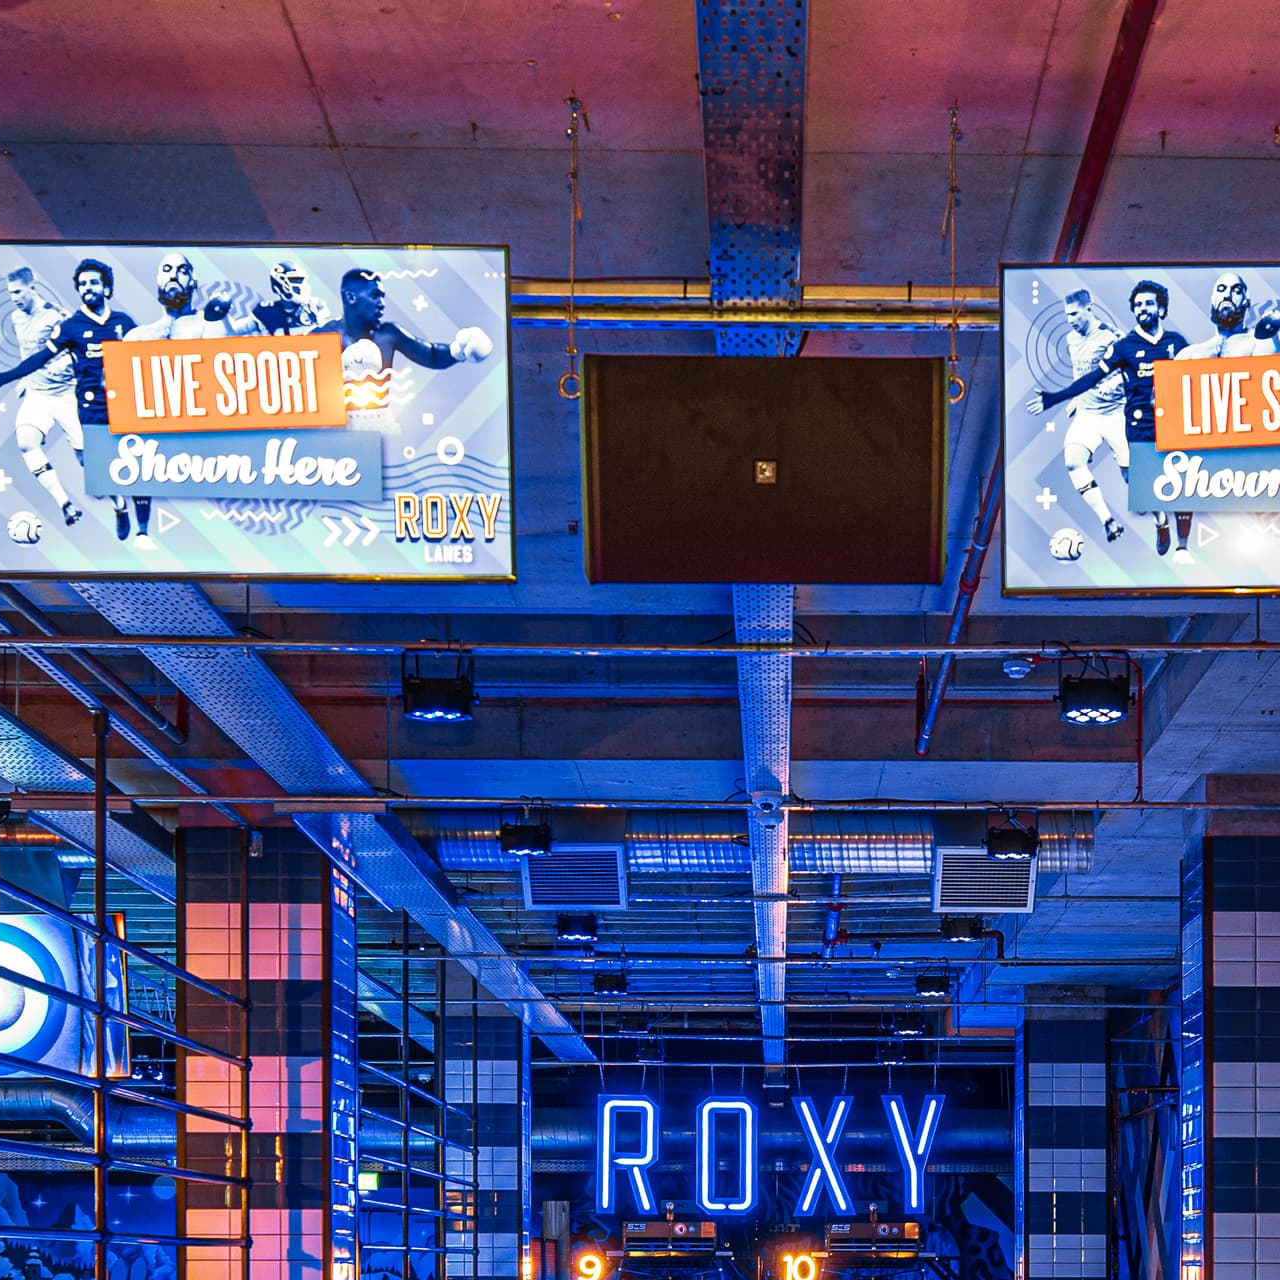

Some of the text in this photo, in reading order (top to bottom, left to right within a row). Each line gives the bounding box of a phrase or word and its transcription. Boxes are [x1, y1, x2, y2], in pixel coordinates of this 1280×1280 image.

[131, 350, 320, 419] LIVE SPORT
[1181, 371, 1253, 436] LIVE
[109, 434, 361, 487] Shown Here
[394, 492, 502, 543] ROXY
[424, 545, 473, 564] LANES
[596, 1094, 946, 1216] ROXY
